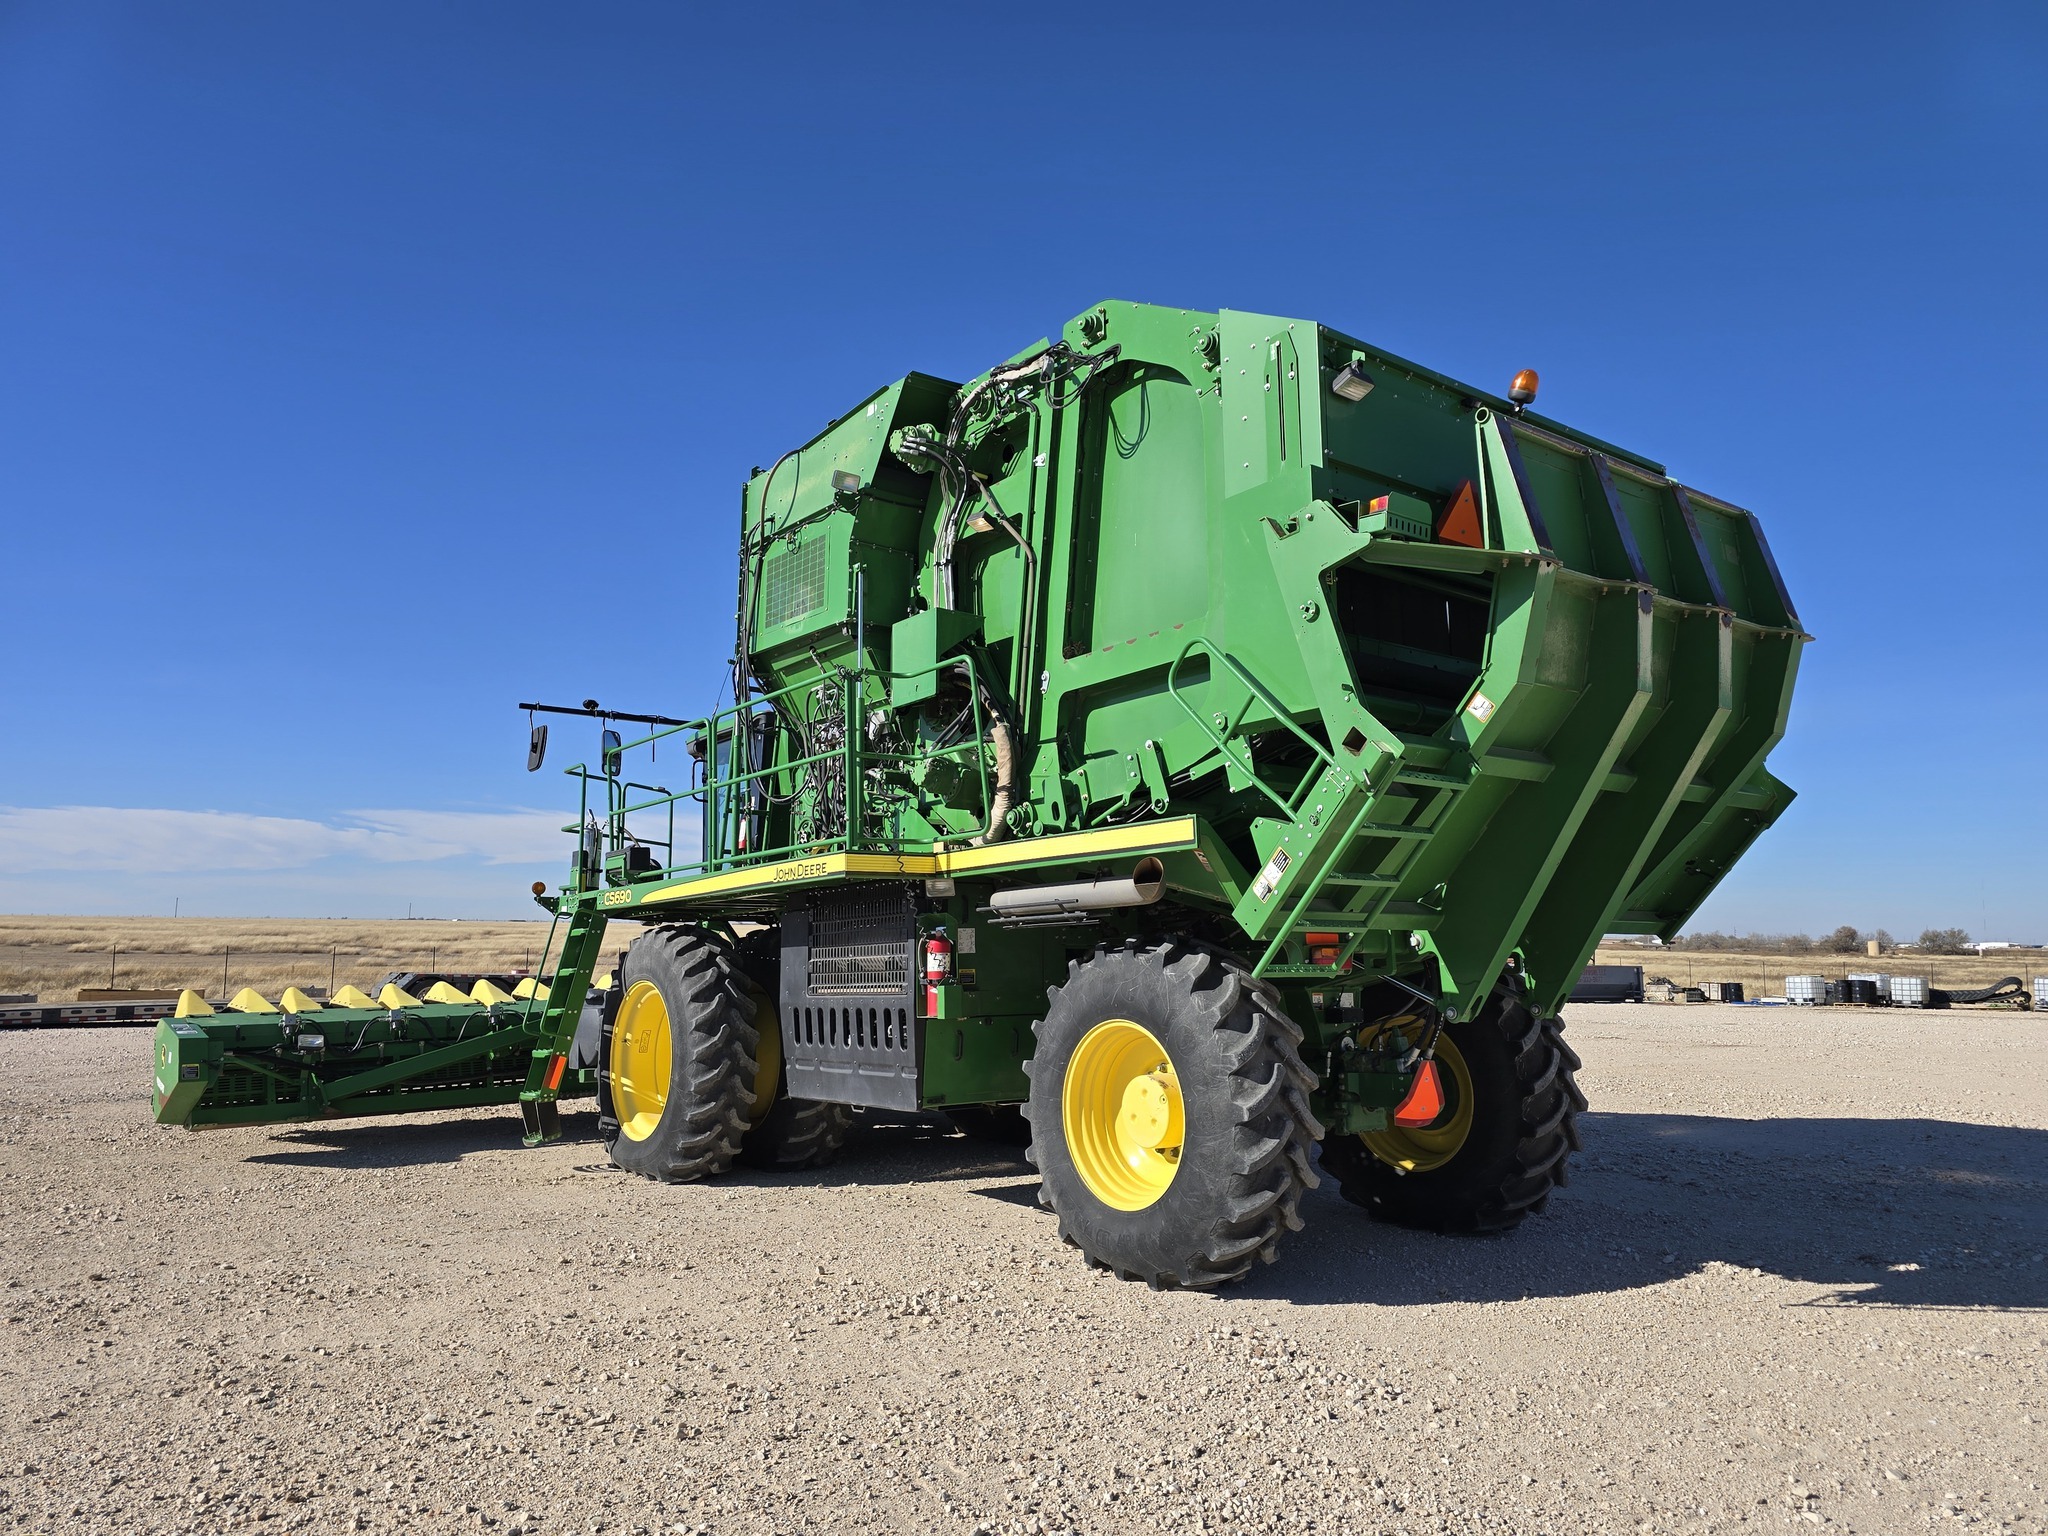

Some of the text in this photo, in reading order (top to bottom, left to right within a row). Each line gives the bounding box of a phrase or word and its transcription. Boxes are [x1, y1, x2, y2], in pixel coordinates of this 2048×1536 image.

[773, 862, 827, 881] JOHN DEERE
[604, 889, 632, 906] CS690
